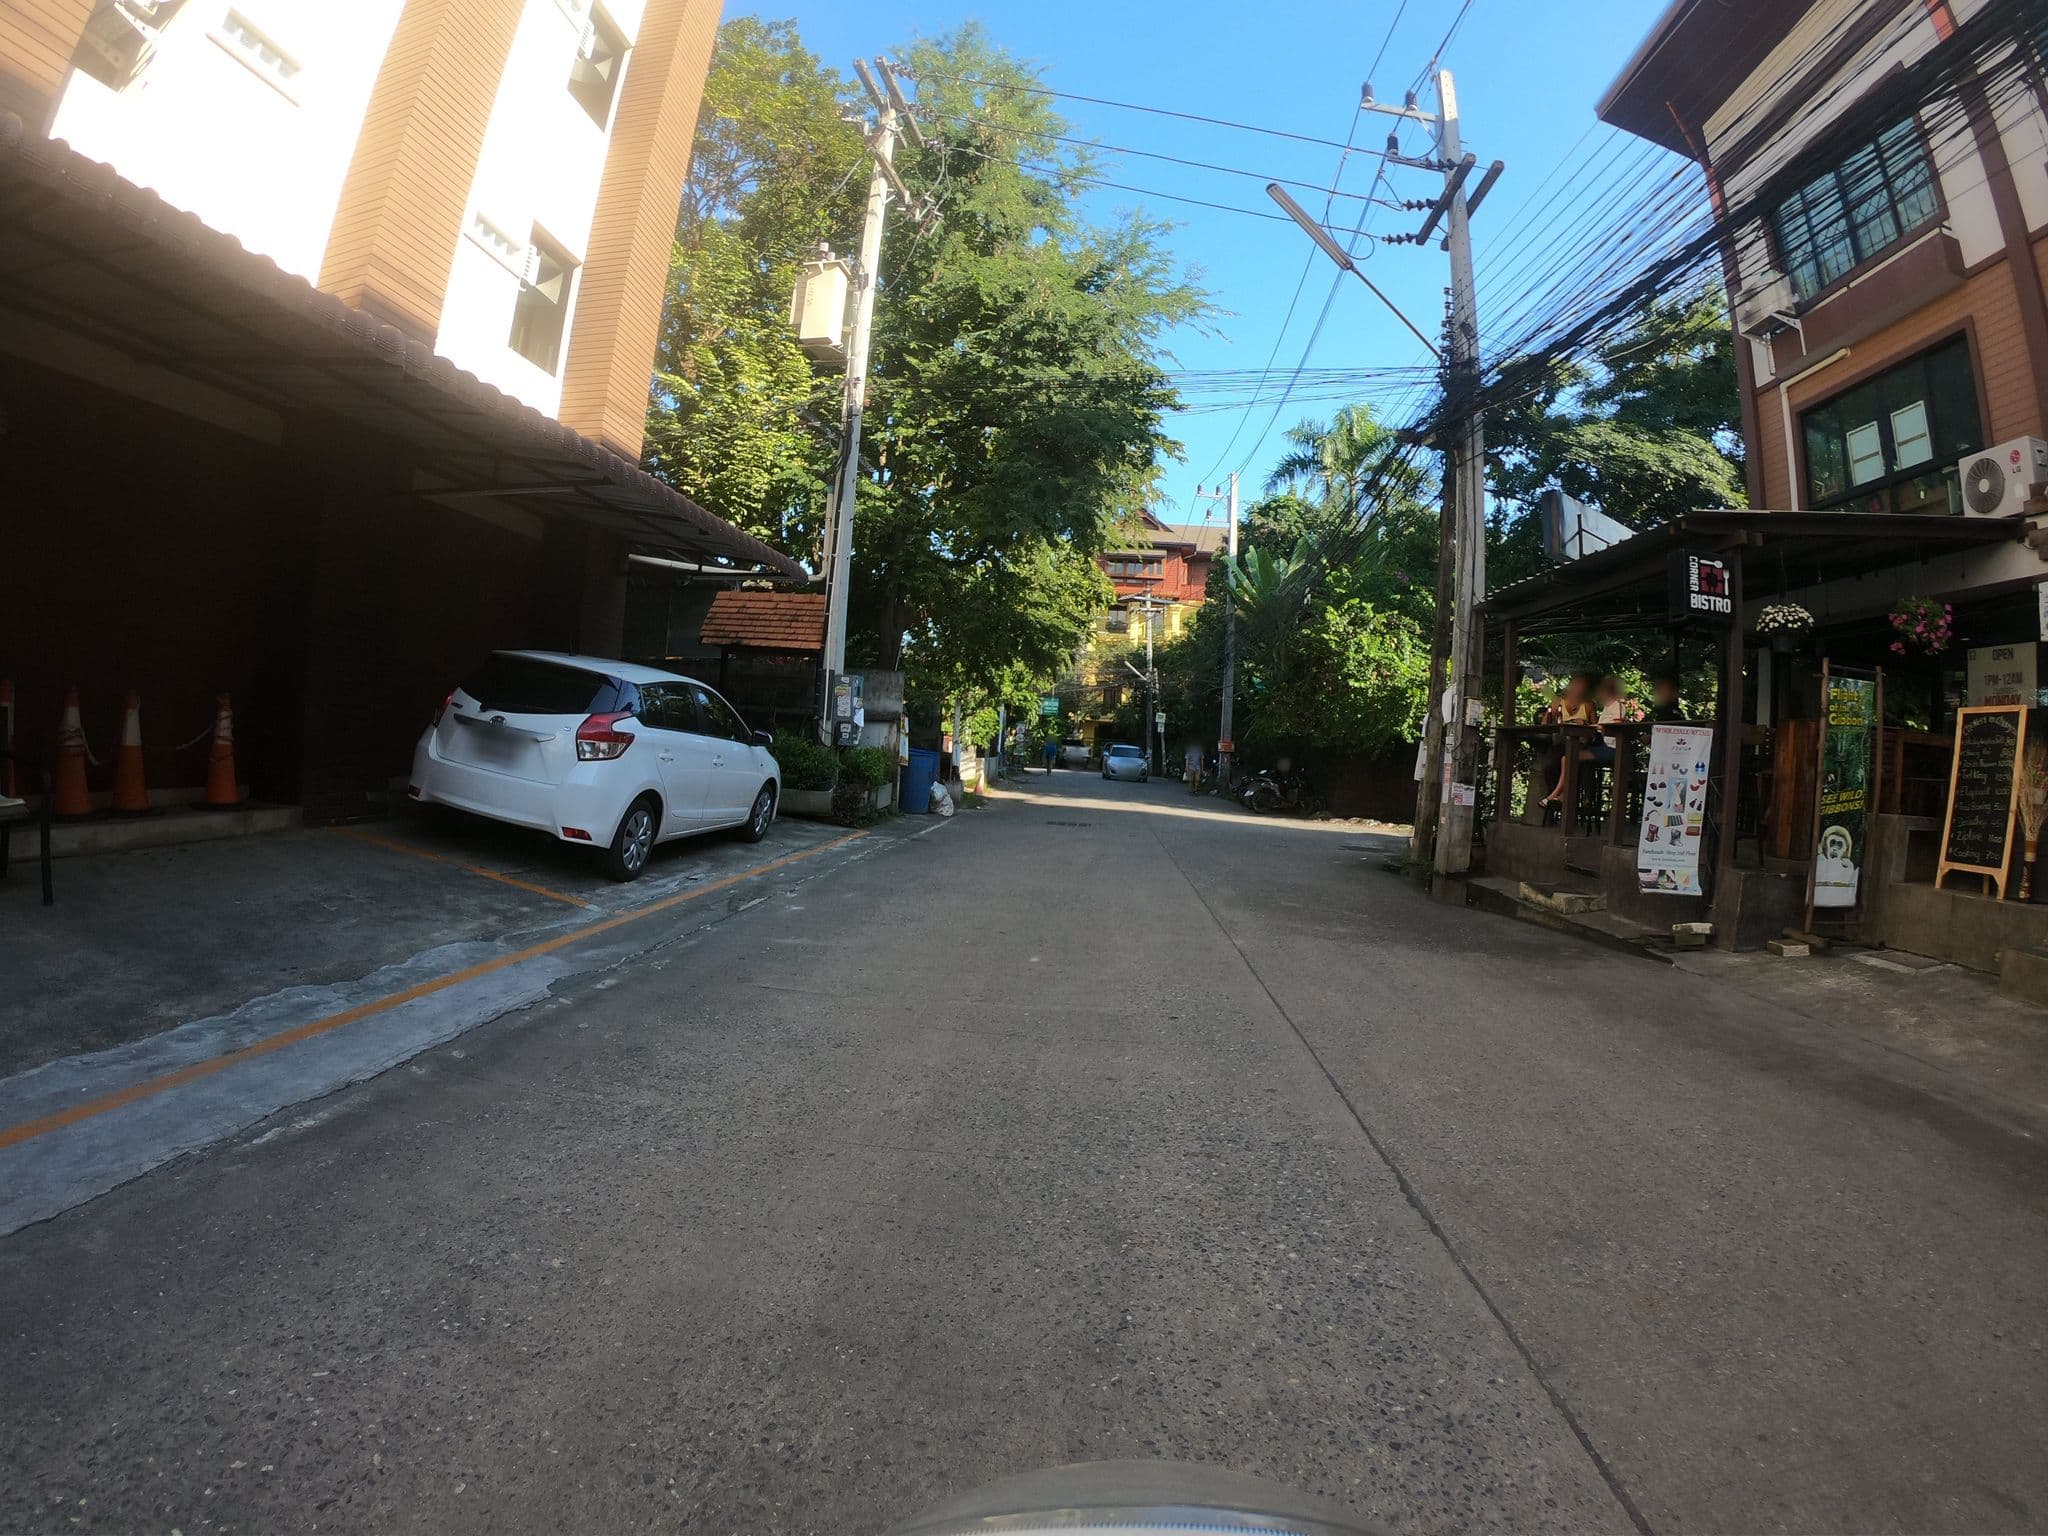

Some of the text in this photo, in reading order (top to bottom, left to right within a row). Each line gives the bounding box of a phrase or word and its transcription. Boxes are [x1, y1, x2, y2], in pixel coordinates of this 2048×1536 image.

[2012, 465, 2022, 474] LG
[1689, 555, 1699, 592] CORNER
[1690, 593, 1731, 613] BISTRO
[1992, 648, 2014, 661] OPEN
[1829, 688, 1858, 703] Flight
[1984, 694, 2022, 706] MONDAY
[1828, 713, 1863, 726] Gibbon
[1821, 789, 1863, 805] SEE WILD
